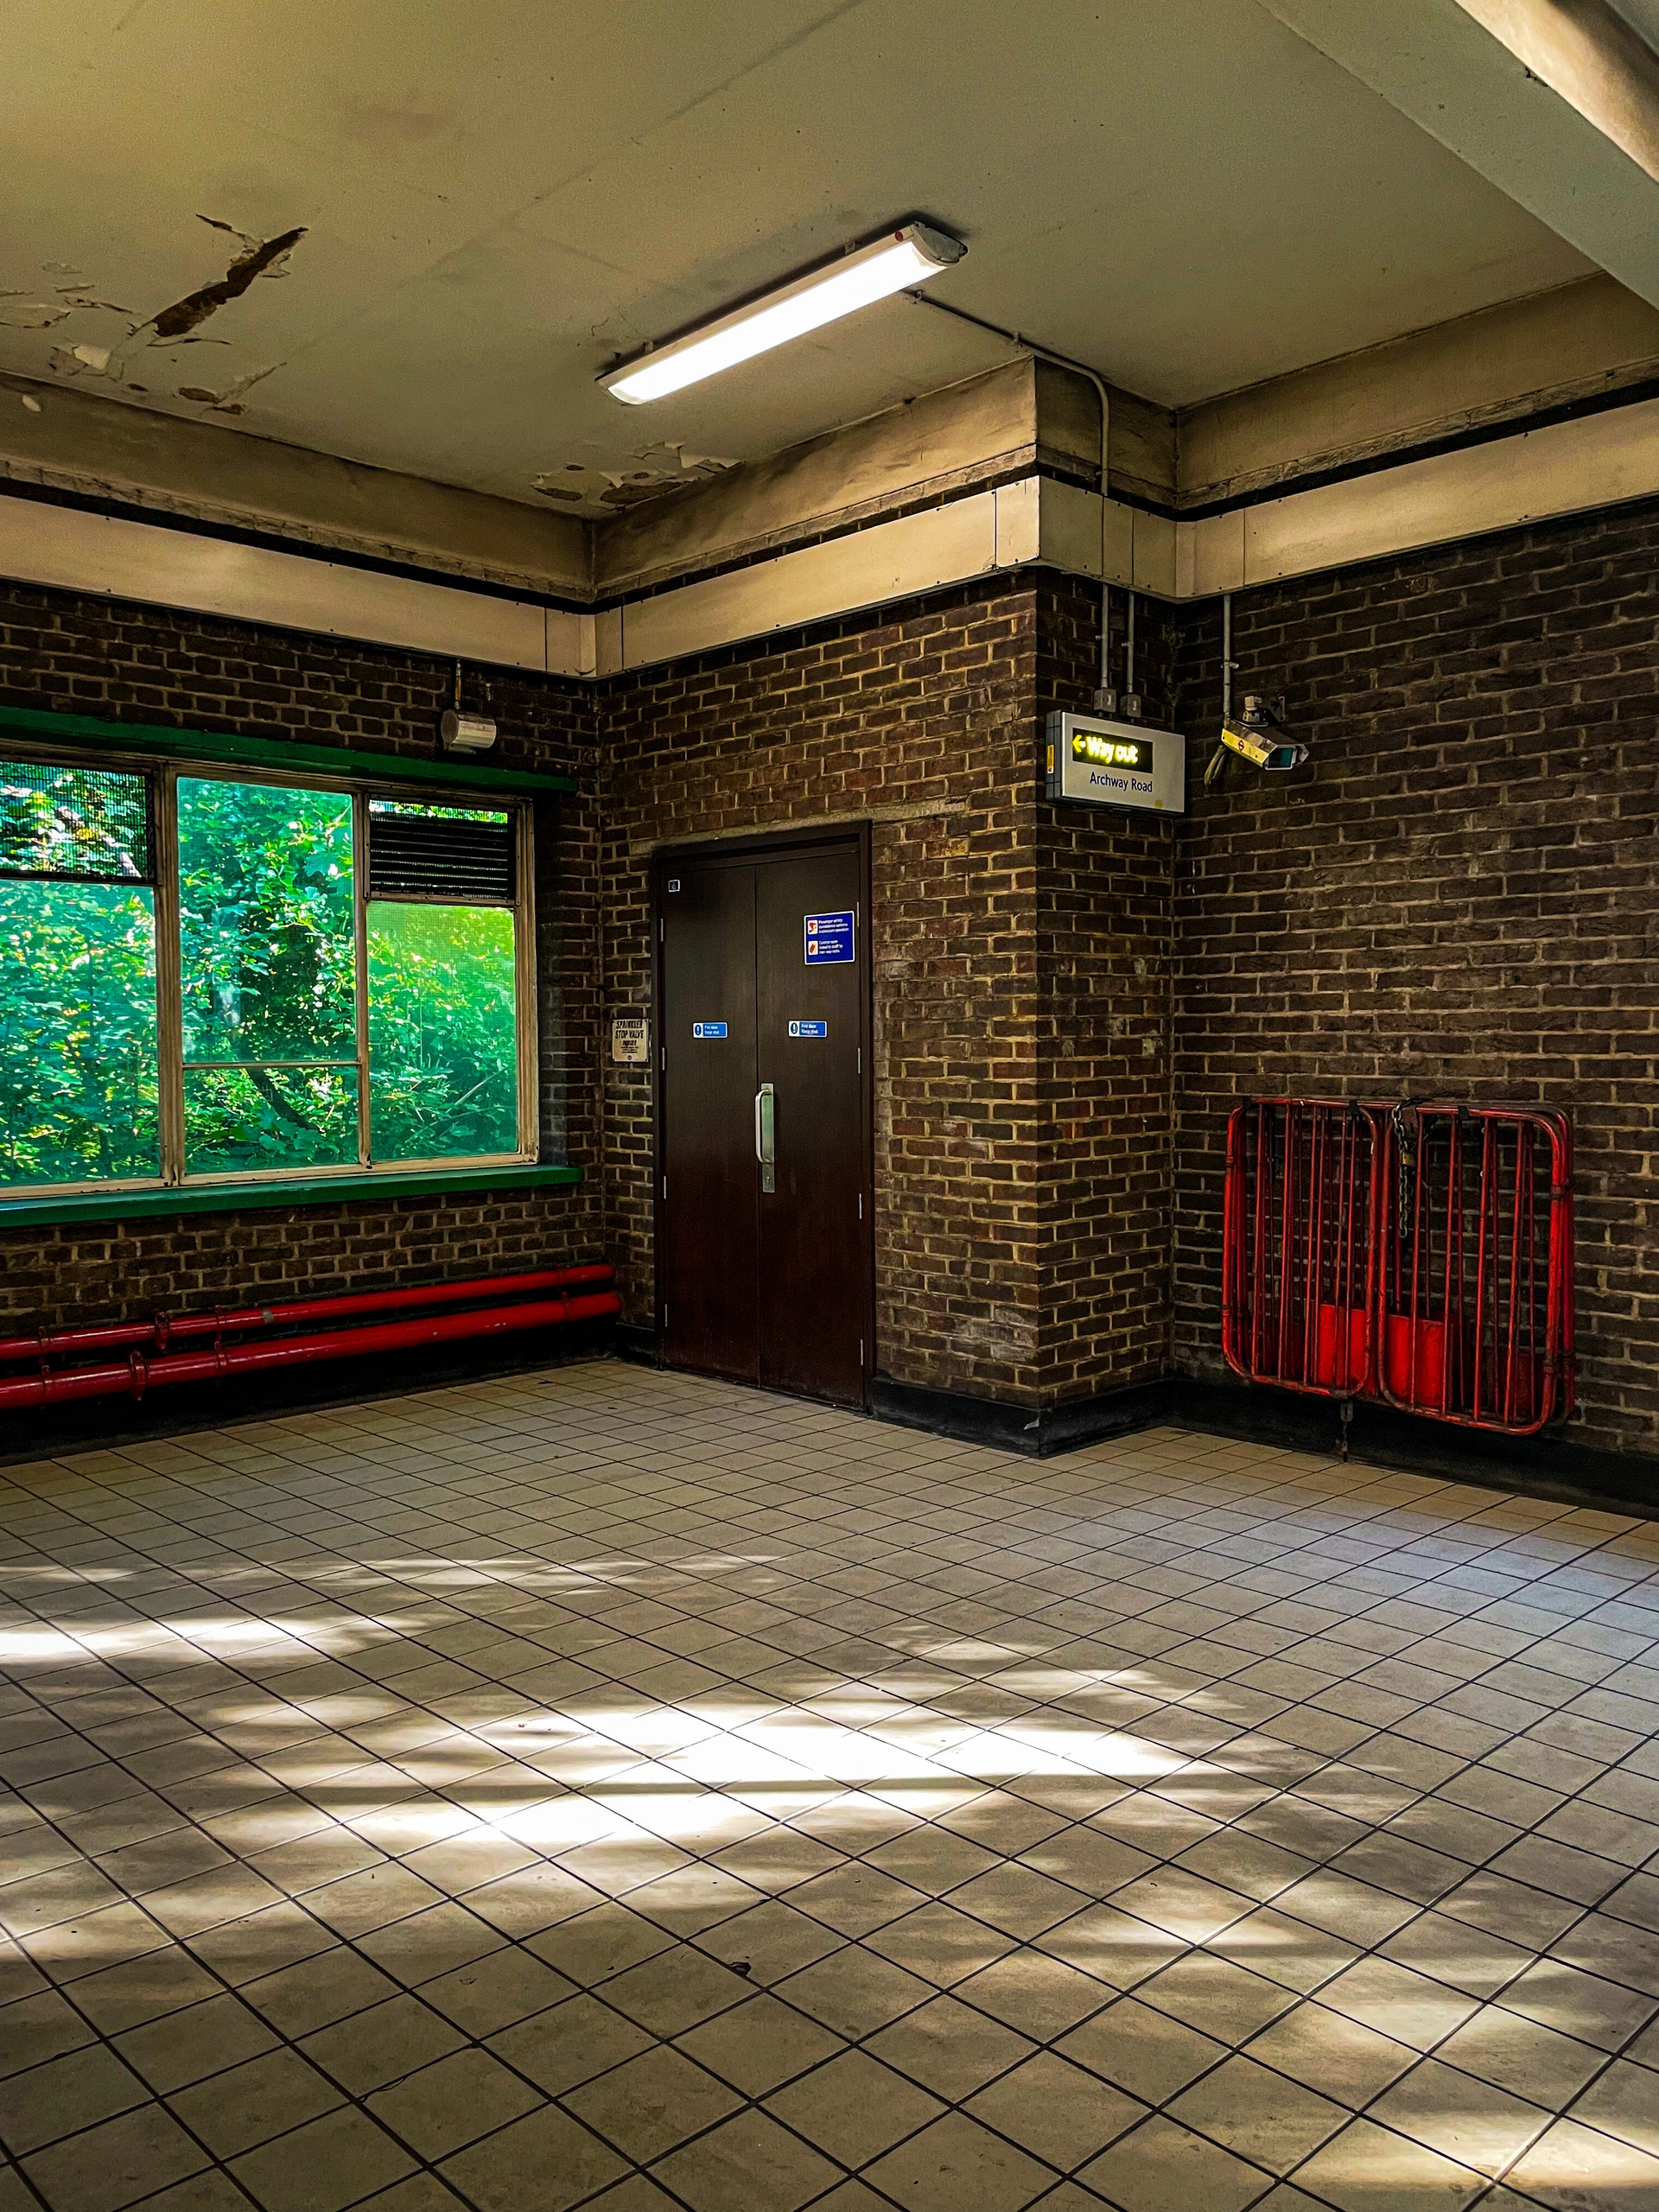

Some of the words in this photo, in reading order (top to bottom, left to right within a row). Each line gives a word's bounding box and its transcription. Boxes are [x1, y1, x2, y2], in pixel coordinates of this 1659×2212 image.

[1085, 735, 1115, 764] Way
[1115, 743, 1139, 764] out
[1090, 772, 1128, 792] Archway
[1131, 778, 1153, 793] Road
[616, 1020, 643, 1029] SPRINKLER
[615, 1030, 628, 1039] STOP
[629, 1029, 644, 1039] VALVE
